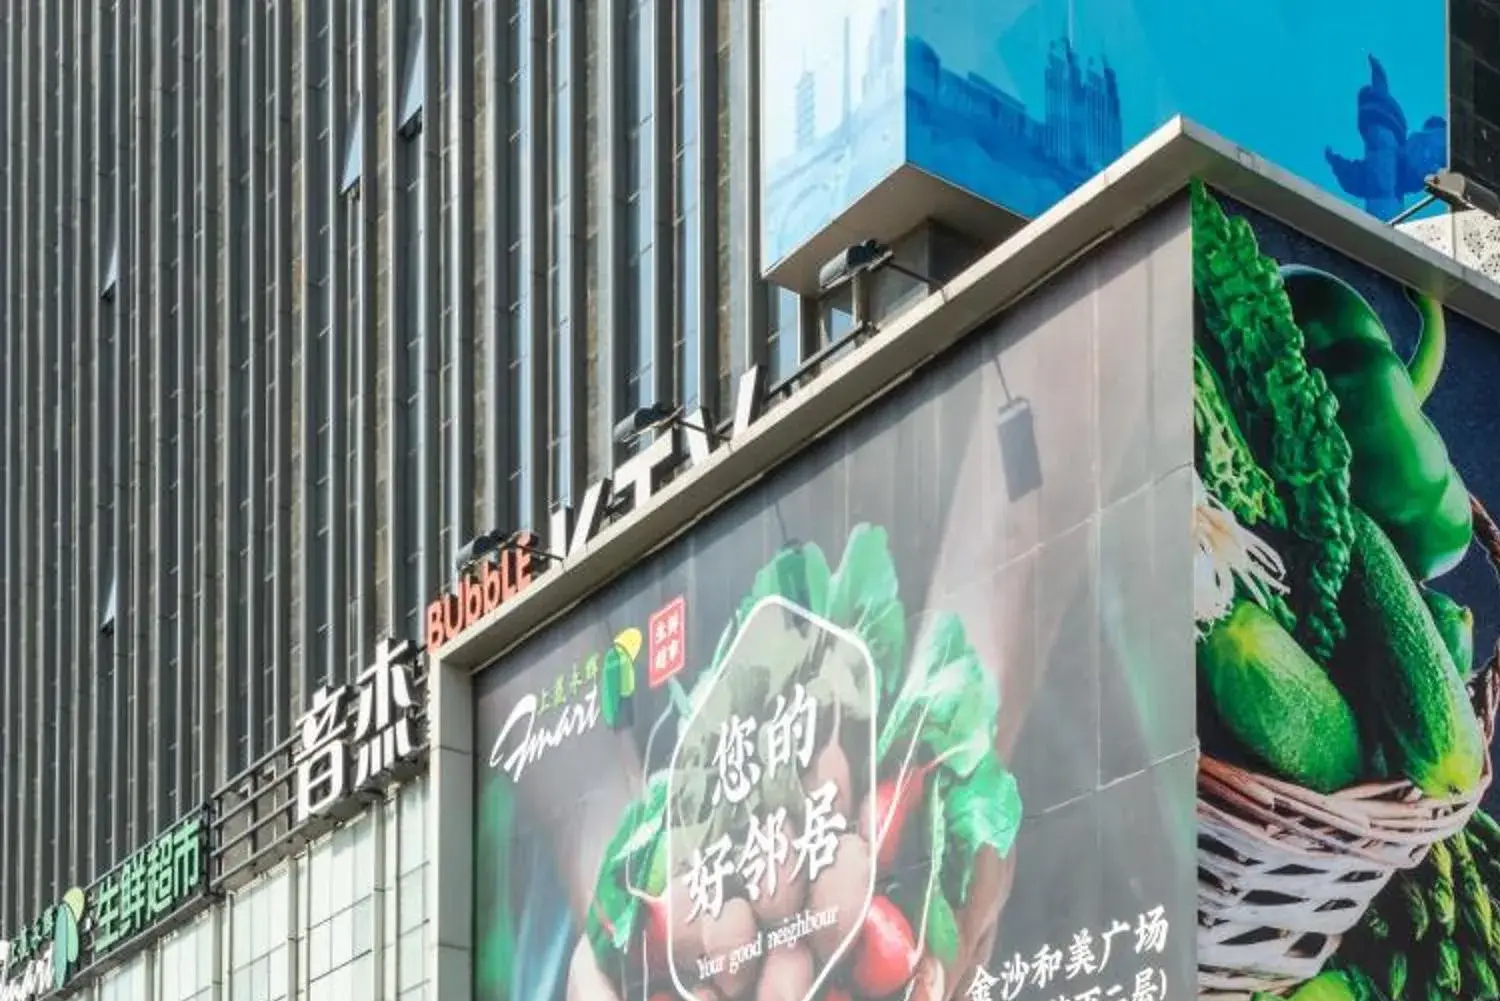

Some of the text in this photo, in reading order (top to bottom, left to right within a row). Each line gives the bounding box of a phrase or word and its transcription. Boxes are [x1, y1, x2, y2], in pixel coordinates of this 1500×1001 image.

[711, 683, 817, 804] 您的
[95, 813, 201, 952] 生鲜超市
[683, 780, 847, 923] 好邻居
[697, 905, 839, 980] Your good neighbour
